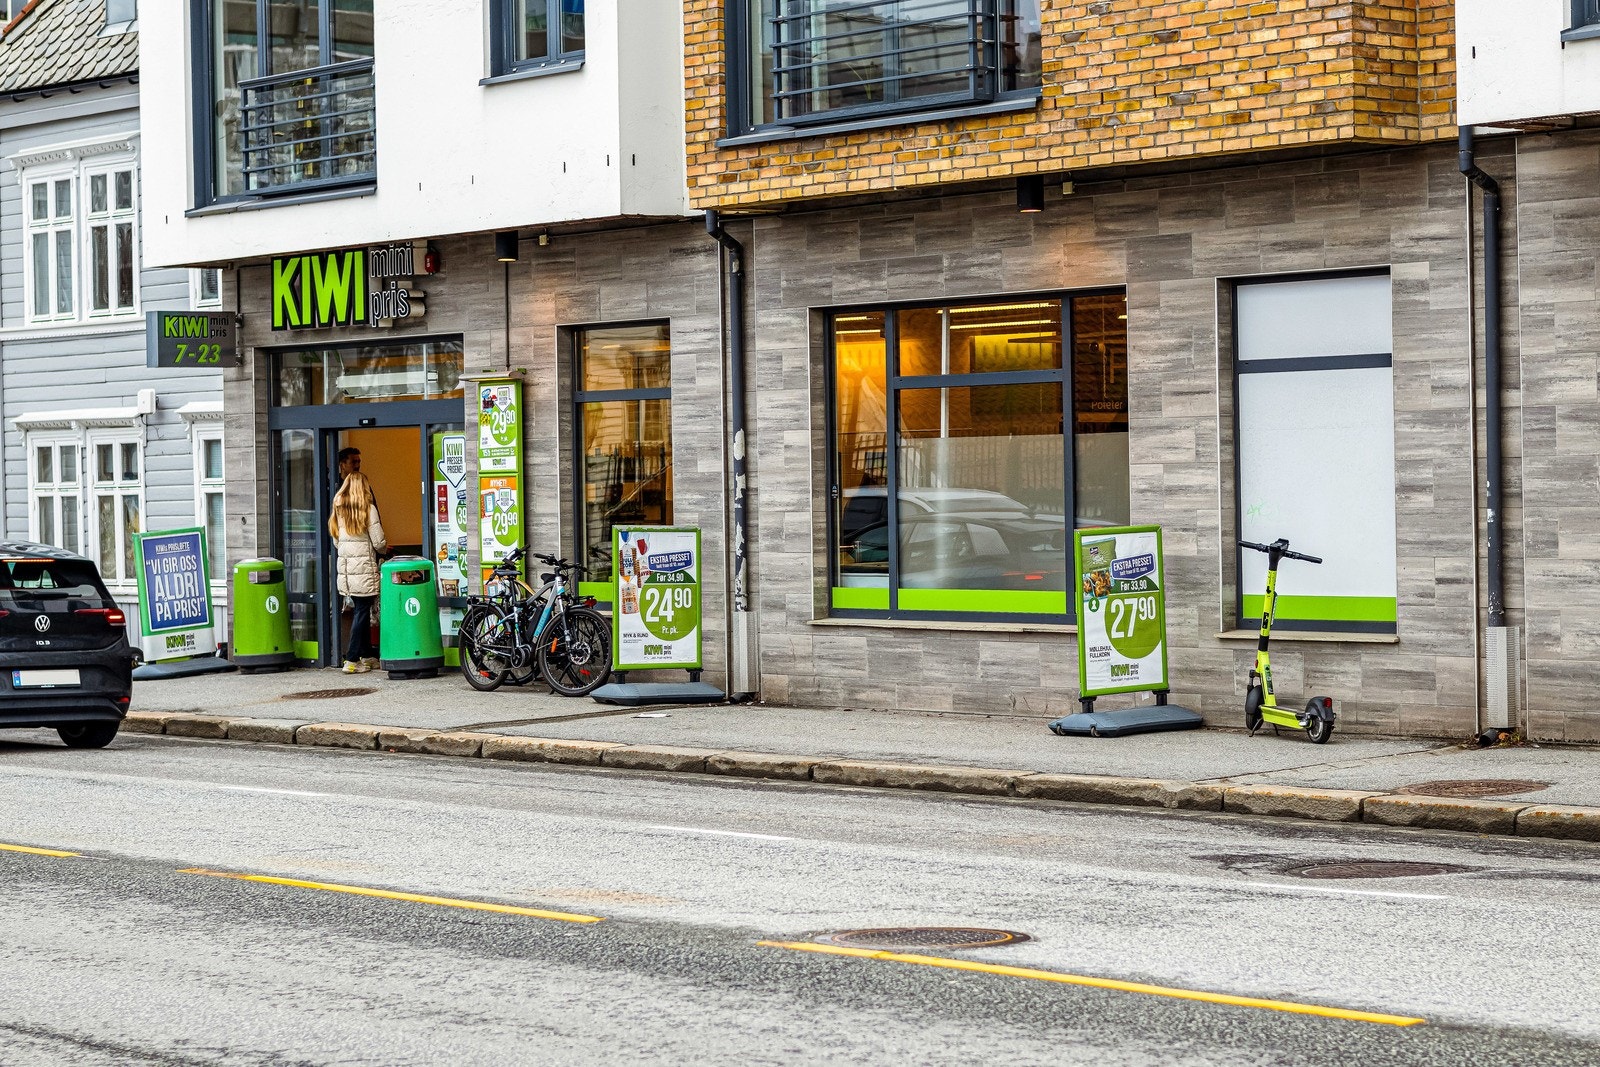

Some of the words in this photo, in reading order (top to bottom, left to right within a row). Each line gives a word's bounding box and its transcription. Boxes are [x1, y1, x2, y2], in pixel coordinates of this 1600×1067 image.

[272, 250, 367, 330] KIWI
[370, 241, 413, 277] mini
[371, 282, 409, 327] pris
[163, 315, 209, 339] KIWI
[210, 316, 229, 326] mini
[210, 327, 227, 339] pris
[174, 344, 221, 364] 7-23
[446, 444, 462, 456] KIWI
[447, 456, 462, 464] PRESSER
[162, 556, 178, 573] GIR
[180, 555, 197, 571] OSS
[651, 555, 668, 564] EKSTRA
[669, 553, 690, 562] PRESSET
[1113, 560, 1132, 571] EKSTRA
[1132, 556, 1152, 568] PRESSET
[667, 572, 684, 582] 34,90
[156, 571, 199, 601] ALDRI
[1130, 580, 1147, 591] 33,90
[156, 597, 172, 622] PÅ
[166, 634, 186, 648] KIWI
[644, 644, 663, 655] KIWI
[1111, 664, 1130, 677] KIWI
